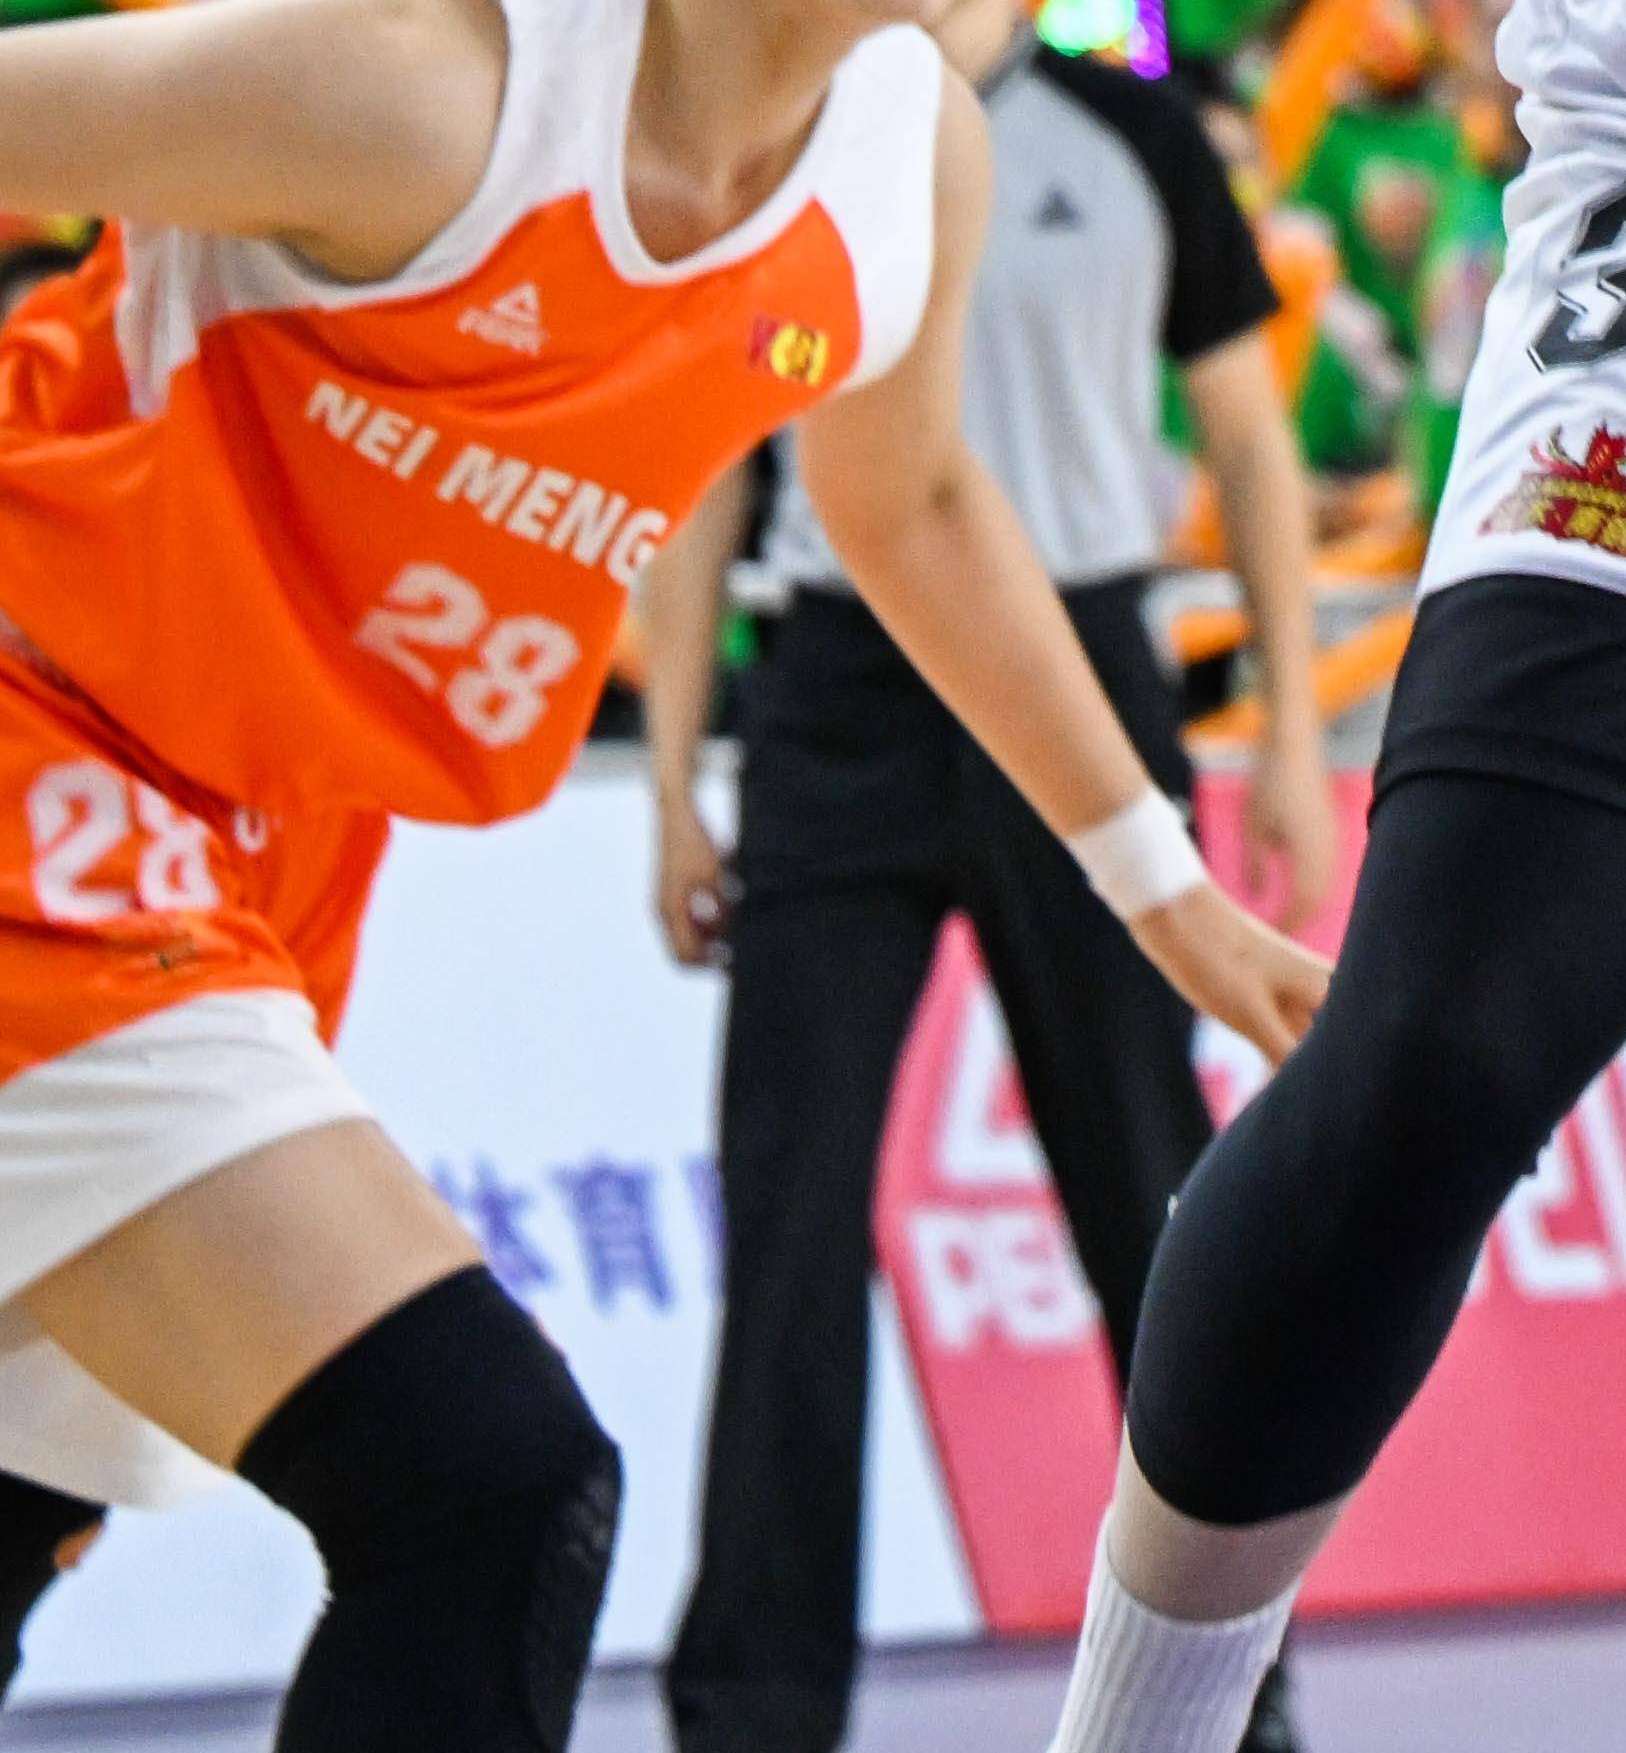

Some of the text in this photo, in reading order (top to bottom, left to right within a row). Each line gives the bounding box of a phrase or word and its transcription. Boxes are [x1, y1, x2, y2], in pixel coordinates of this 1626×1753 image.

[306, 381, 669, 591] NEI MENG
[354, 562, 581, 749] 28
[27, 755, 221, 925] 28
[430, 1148, 728, 1318] 体育
